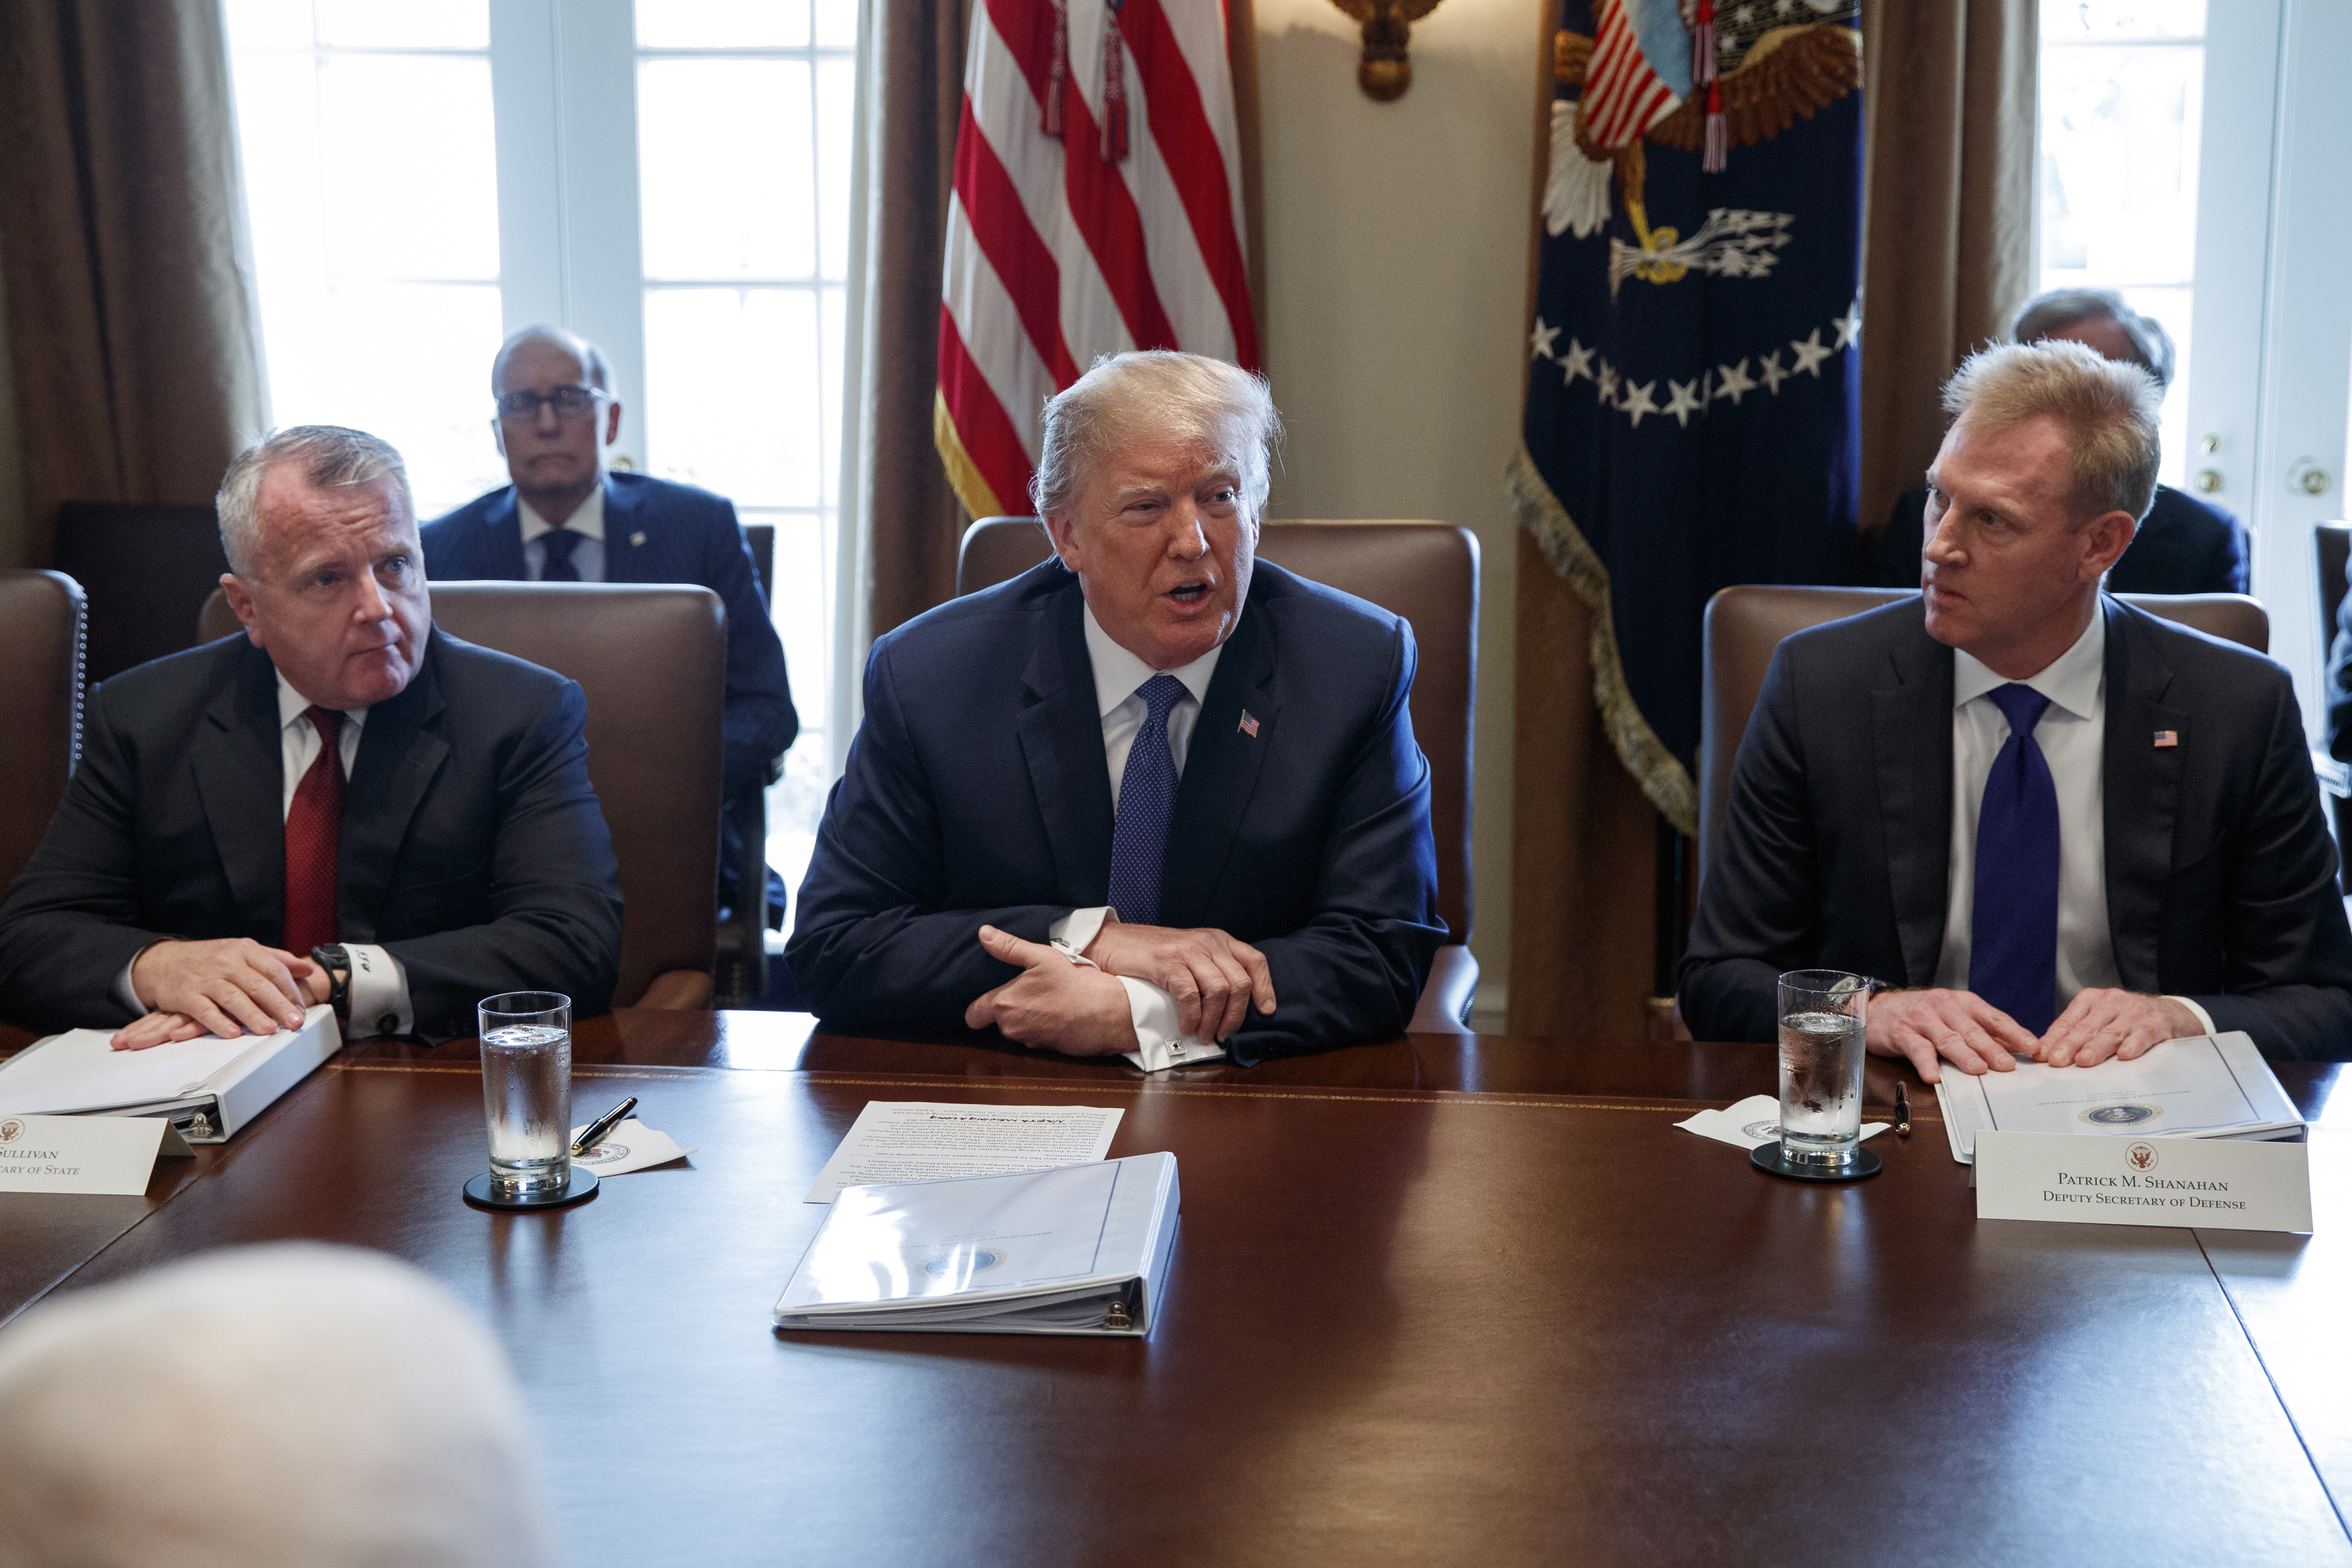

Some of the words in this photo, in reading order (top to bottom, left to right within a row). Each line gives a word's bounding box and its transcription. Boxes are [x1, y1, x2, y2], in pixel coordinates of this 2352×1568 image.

[44, 1164, 80, 1175] STATE
[2058, 1172, 2118, 1186] PATRICK
[2121, 1175, 2141, 1188] M.
[2145, 1176, 2229, 1191] SHANAHAN
[2043, 1190, 2092, 1203] DEPUTY
[2096, 1193, 2166, 1206] SECRETARY
[2170, 1198, 2186, 1207] OF
[2189, 1196, 2246, 1210] DEFENSE
